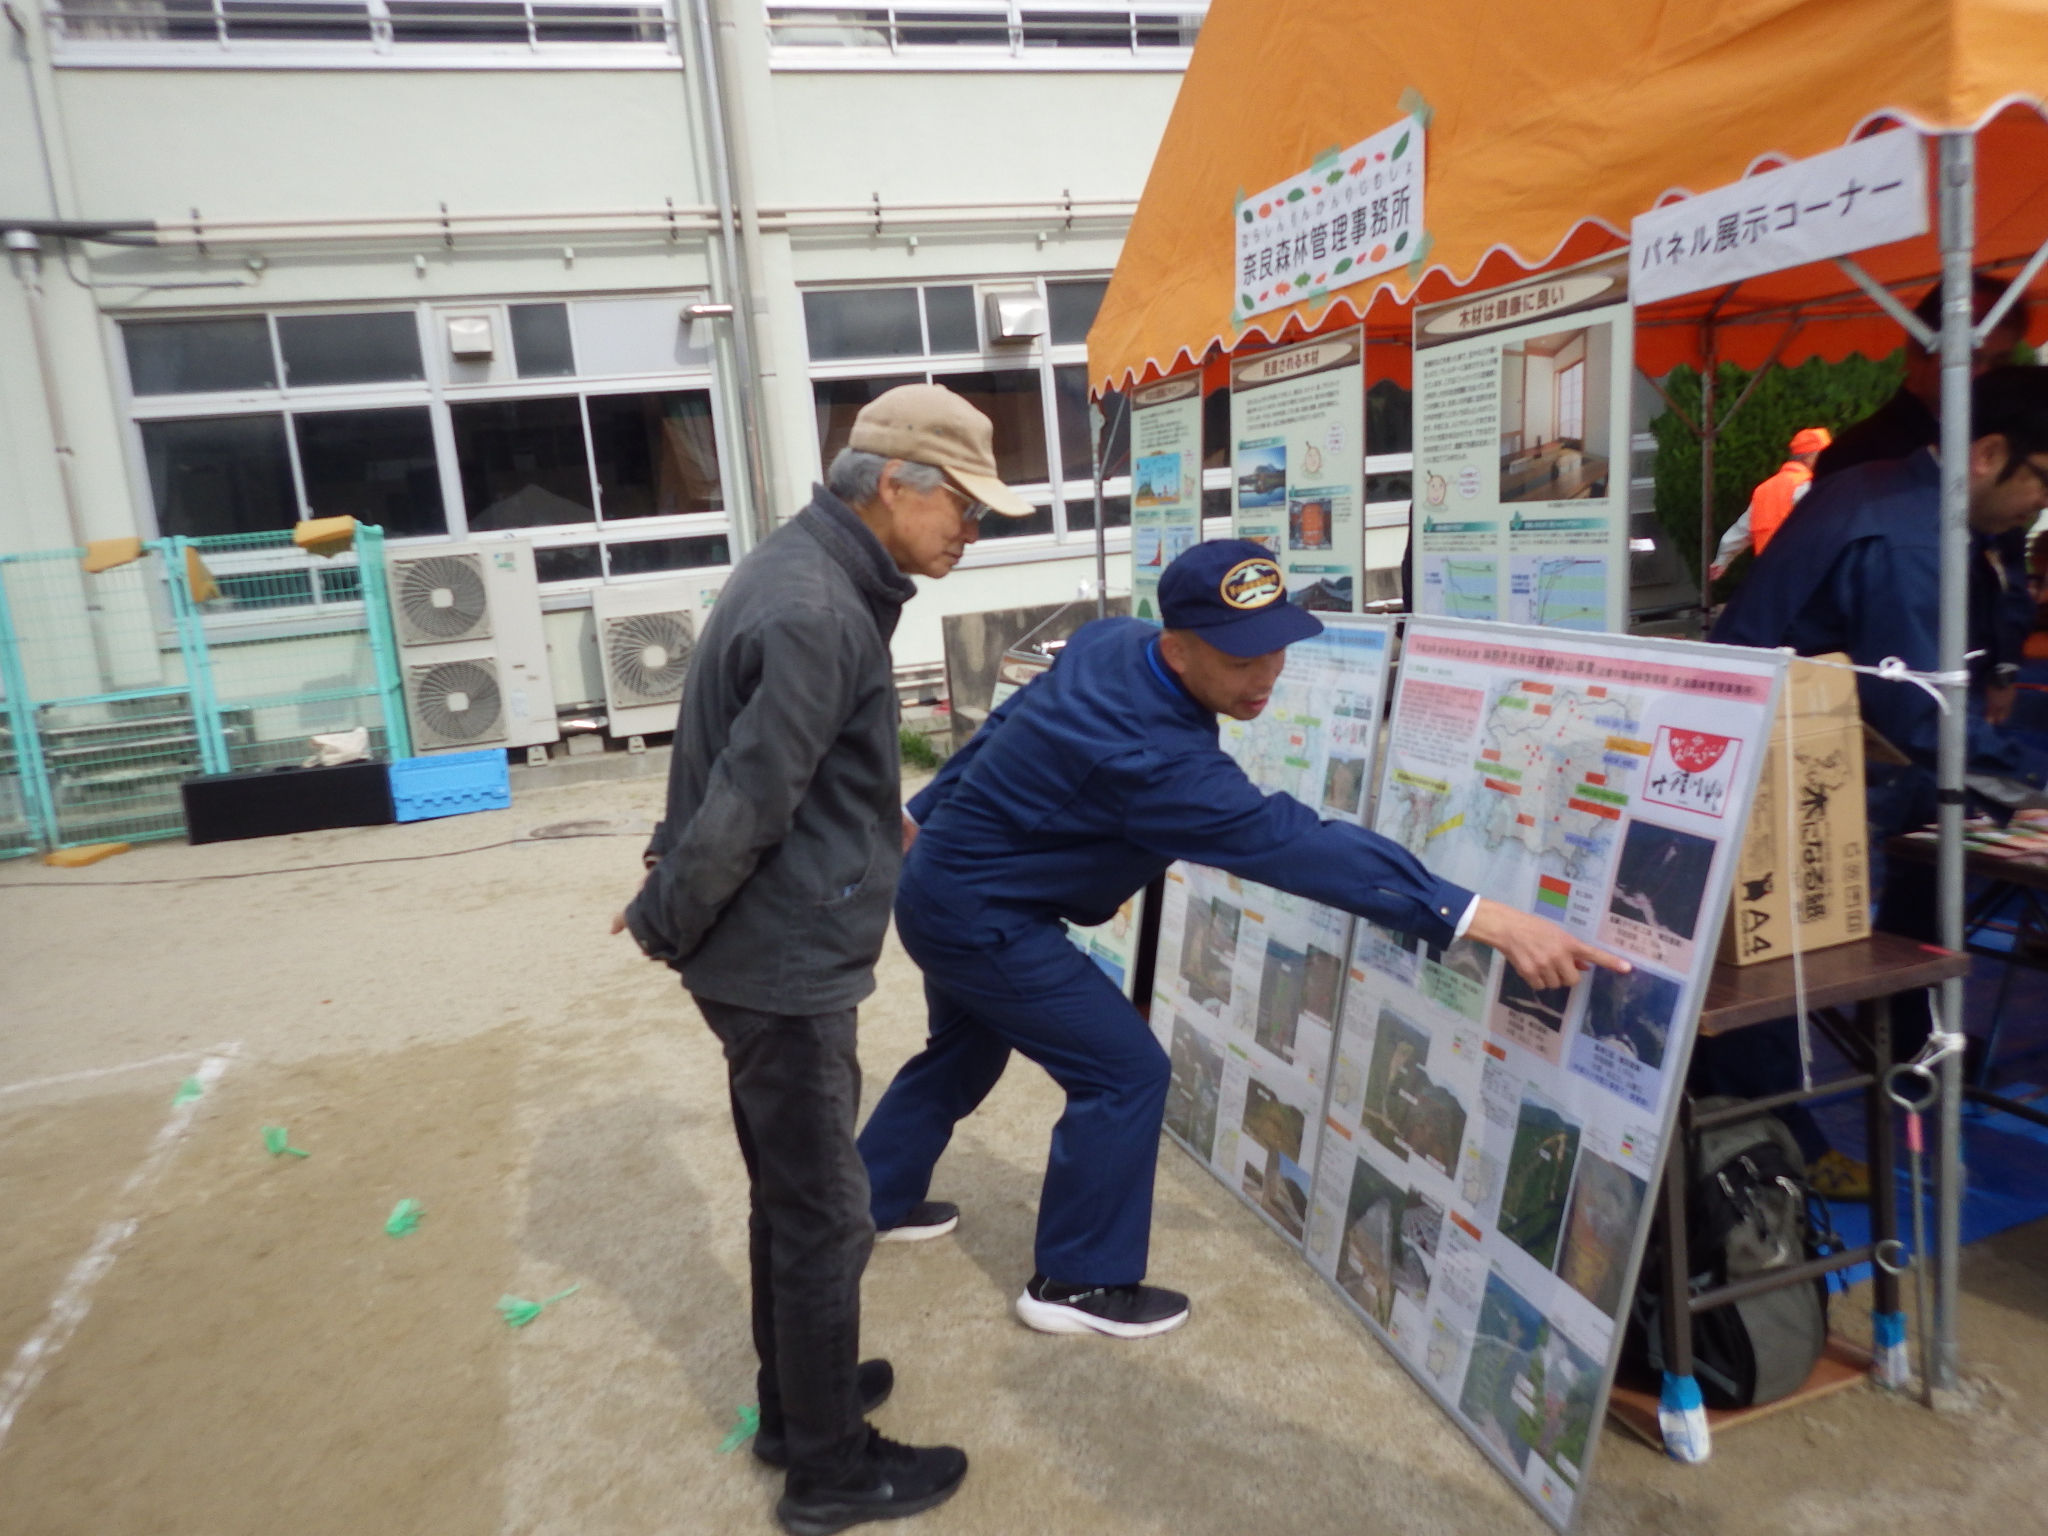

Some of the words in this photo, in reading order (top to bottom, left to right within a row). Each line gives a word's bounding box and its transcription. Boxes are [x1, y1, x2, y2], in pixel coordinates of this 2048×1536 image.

[1242, 162, 1412, 248] ならしんりんかんりじむしょ
[1243, 185, 1411, 286] 奈良森林管理事務所
[1642, 178, 1903, 270] パネル展示コーナー
[1458, 285, 1566, 328] 木材は健康に良い
[1799, 784, 1828, 921] 木になる紙
[1746, 908, 1772, 955] A4
